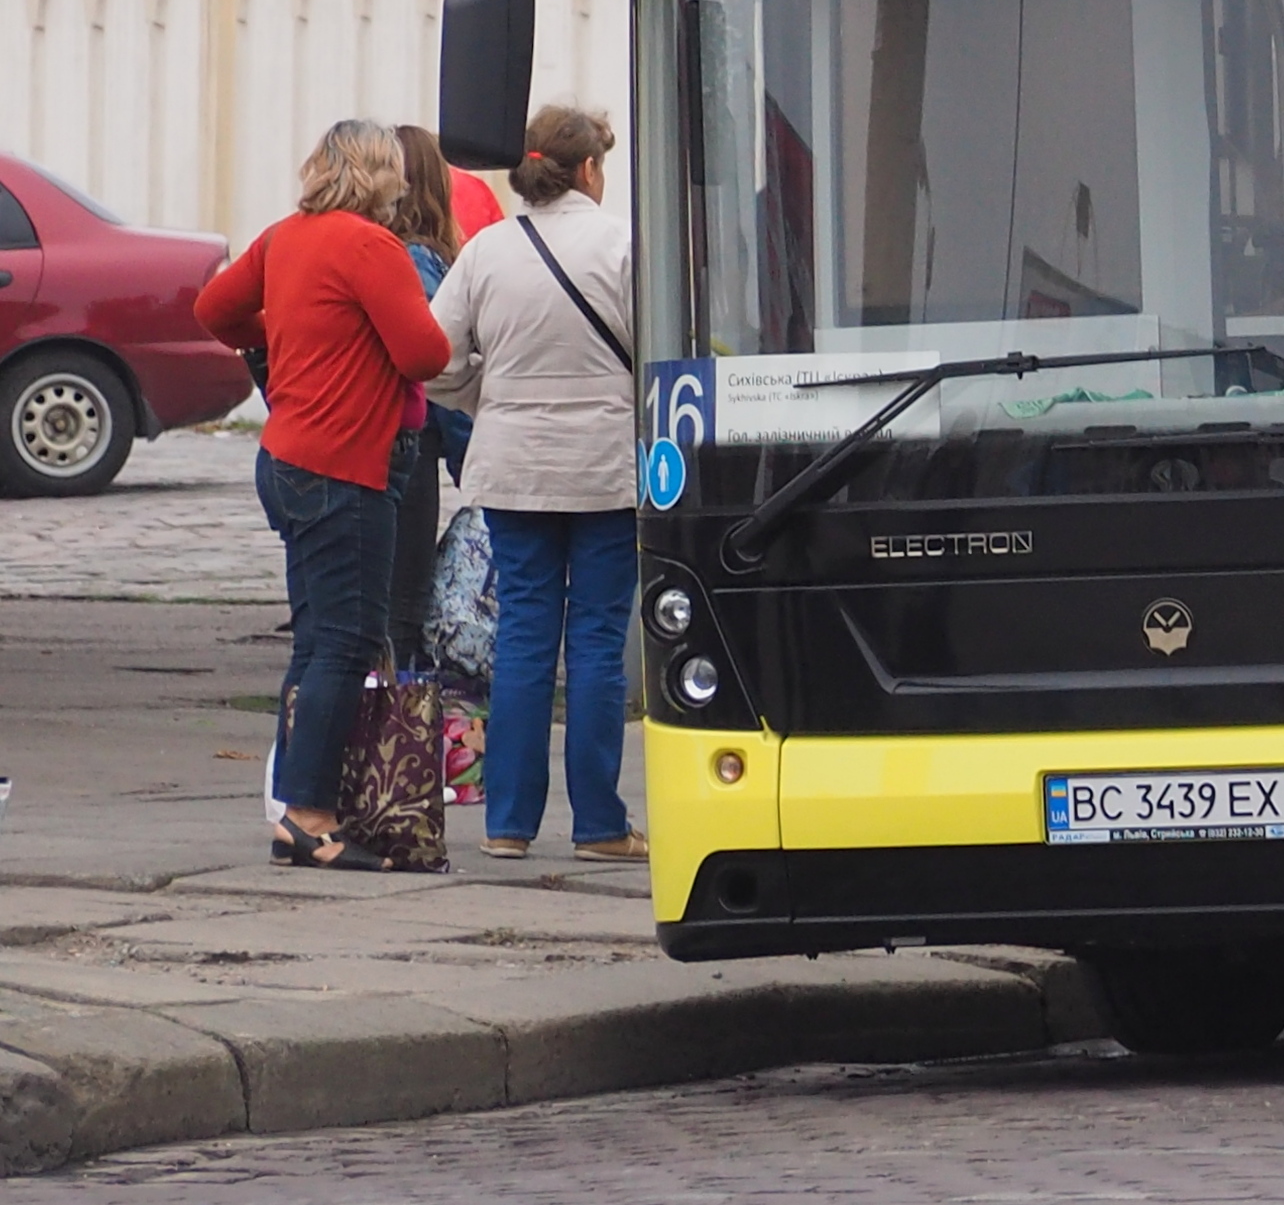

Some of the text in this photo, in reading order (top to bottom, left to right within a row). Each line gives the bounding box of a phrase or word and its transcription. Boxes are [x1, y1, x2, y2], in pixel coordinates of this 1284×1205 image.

[728, 372, 792, 388] Сихівська
[645, 374, 705, 448] 16
[870, 530, 1033, 559] ELECTRON
[1072, 780, 1280, 822] BC 3439 EX
[1051, 811, 1069, 824] UA
